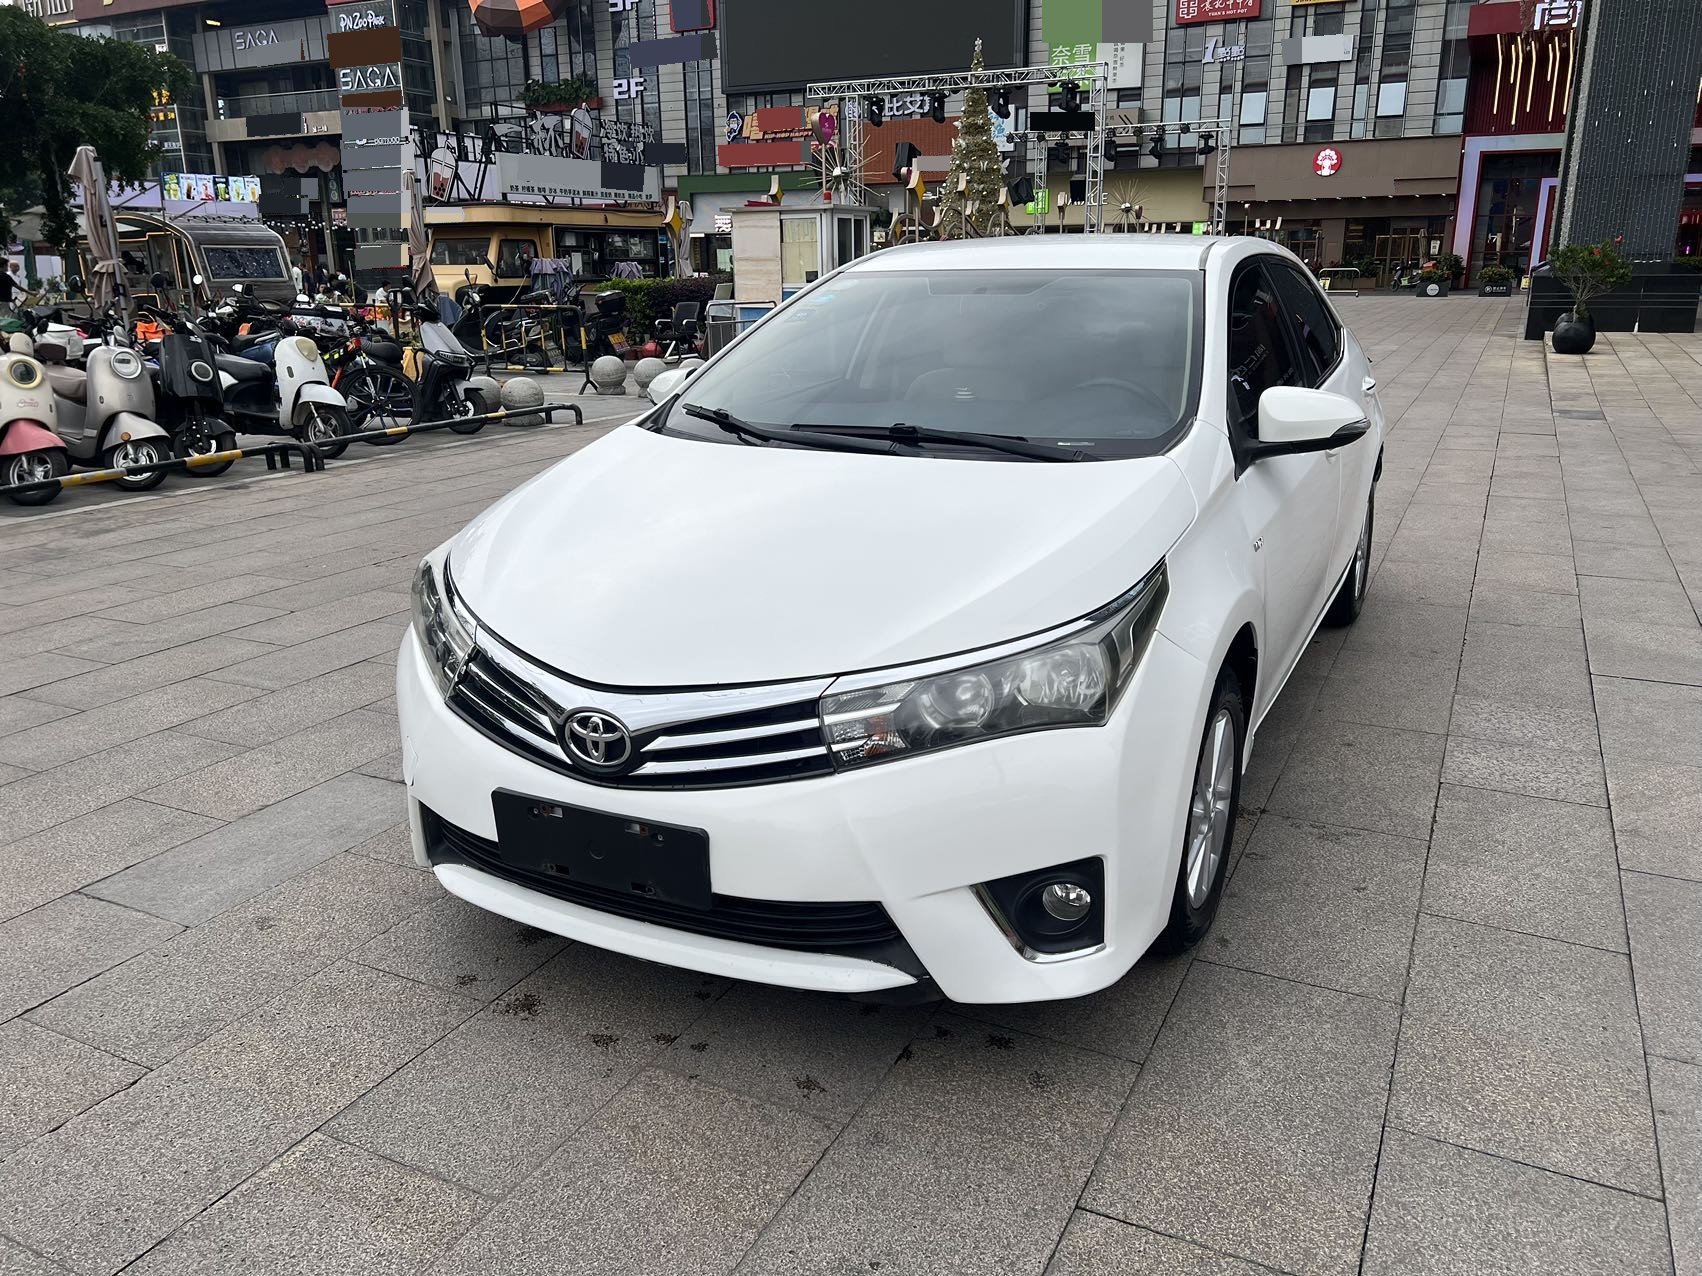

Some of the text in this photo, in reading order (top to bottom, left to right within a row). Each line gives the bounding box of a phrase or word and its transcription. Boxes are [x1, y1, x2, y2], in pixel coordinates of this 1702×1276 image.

[234, 29, 279, 50] SAGA
[1051, 43, 1093, 67] 奈雪
[340, 65, 397, 90] SAGA
[613, 78, 644, 99] 2F
